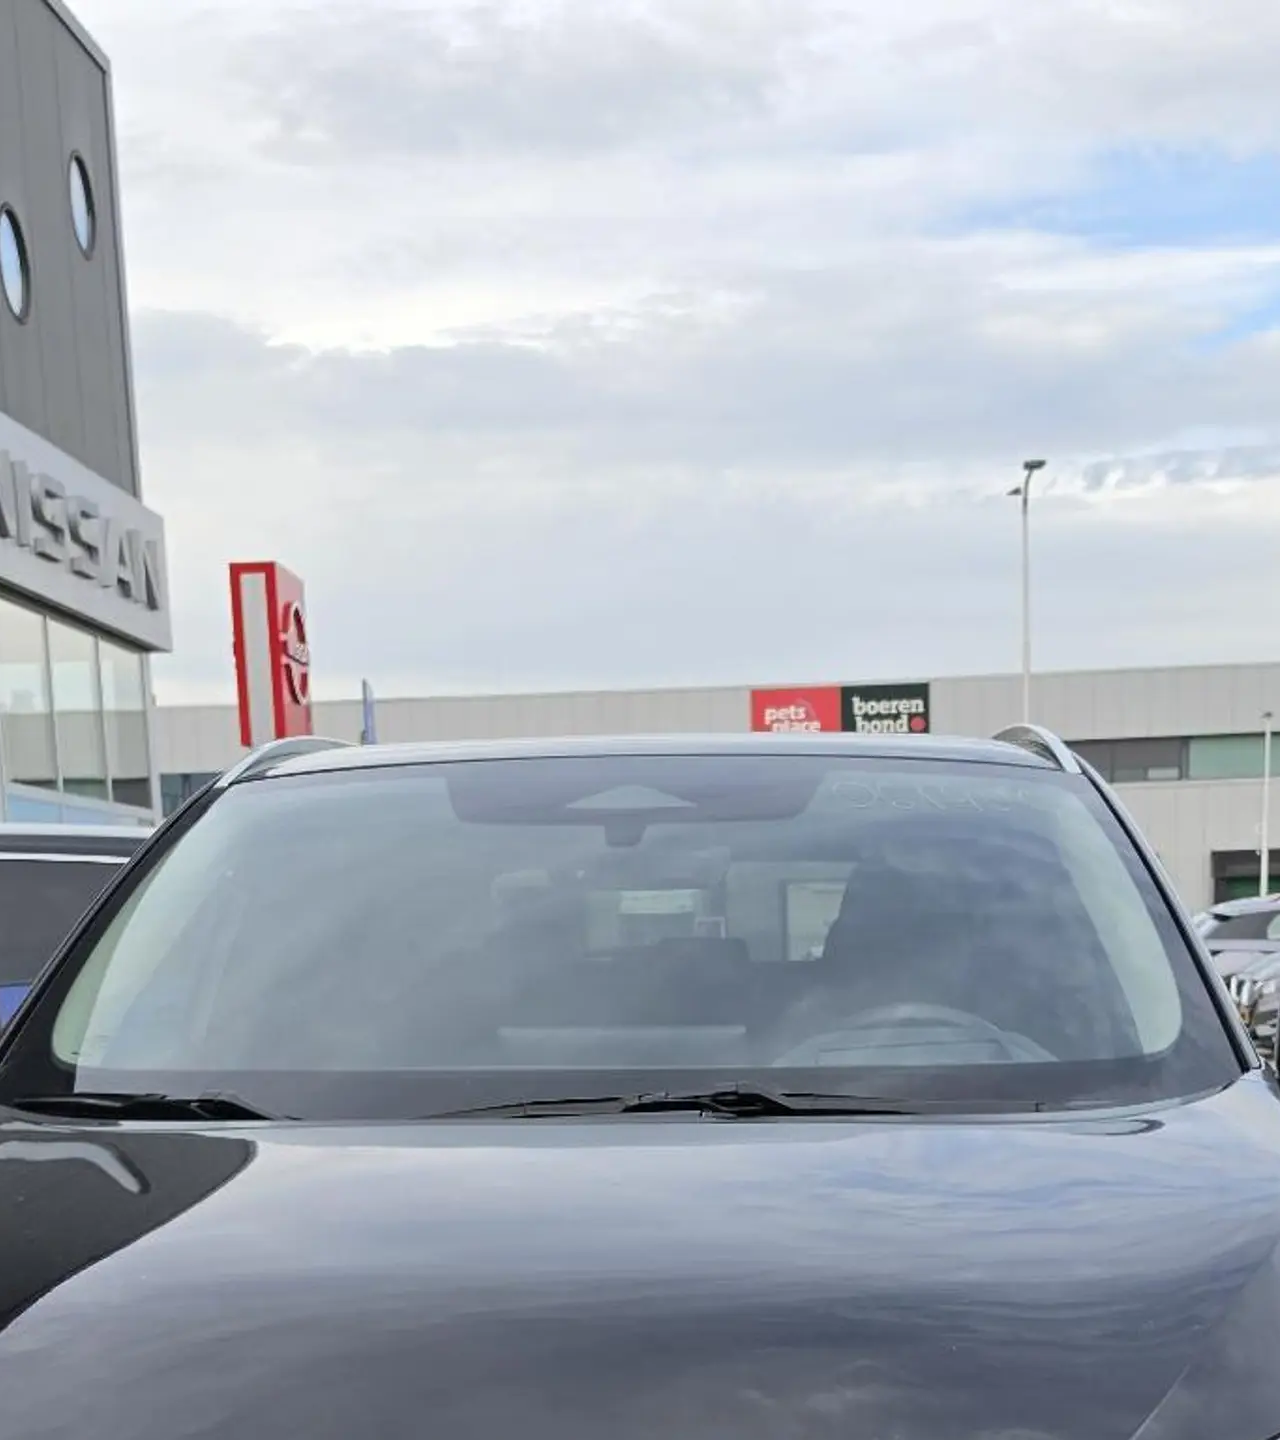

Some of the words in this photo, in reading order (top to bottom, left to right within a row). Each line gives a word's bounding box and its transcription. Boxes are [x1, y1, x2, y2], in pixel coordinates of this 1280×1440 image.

[763, 704, 807, 726] pets
[852, 695, 924, 715] boeren
[855, 715, 910, 733] bond
